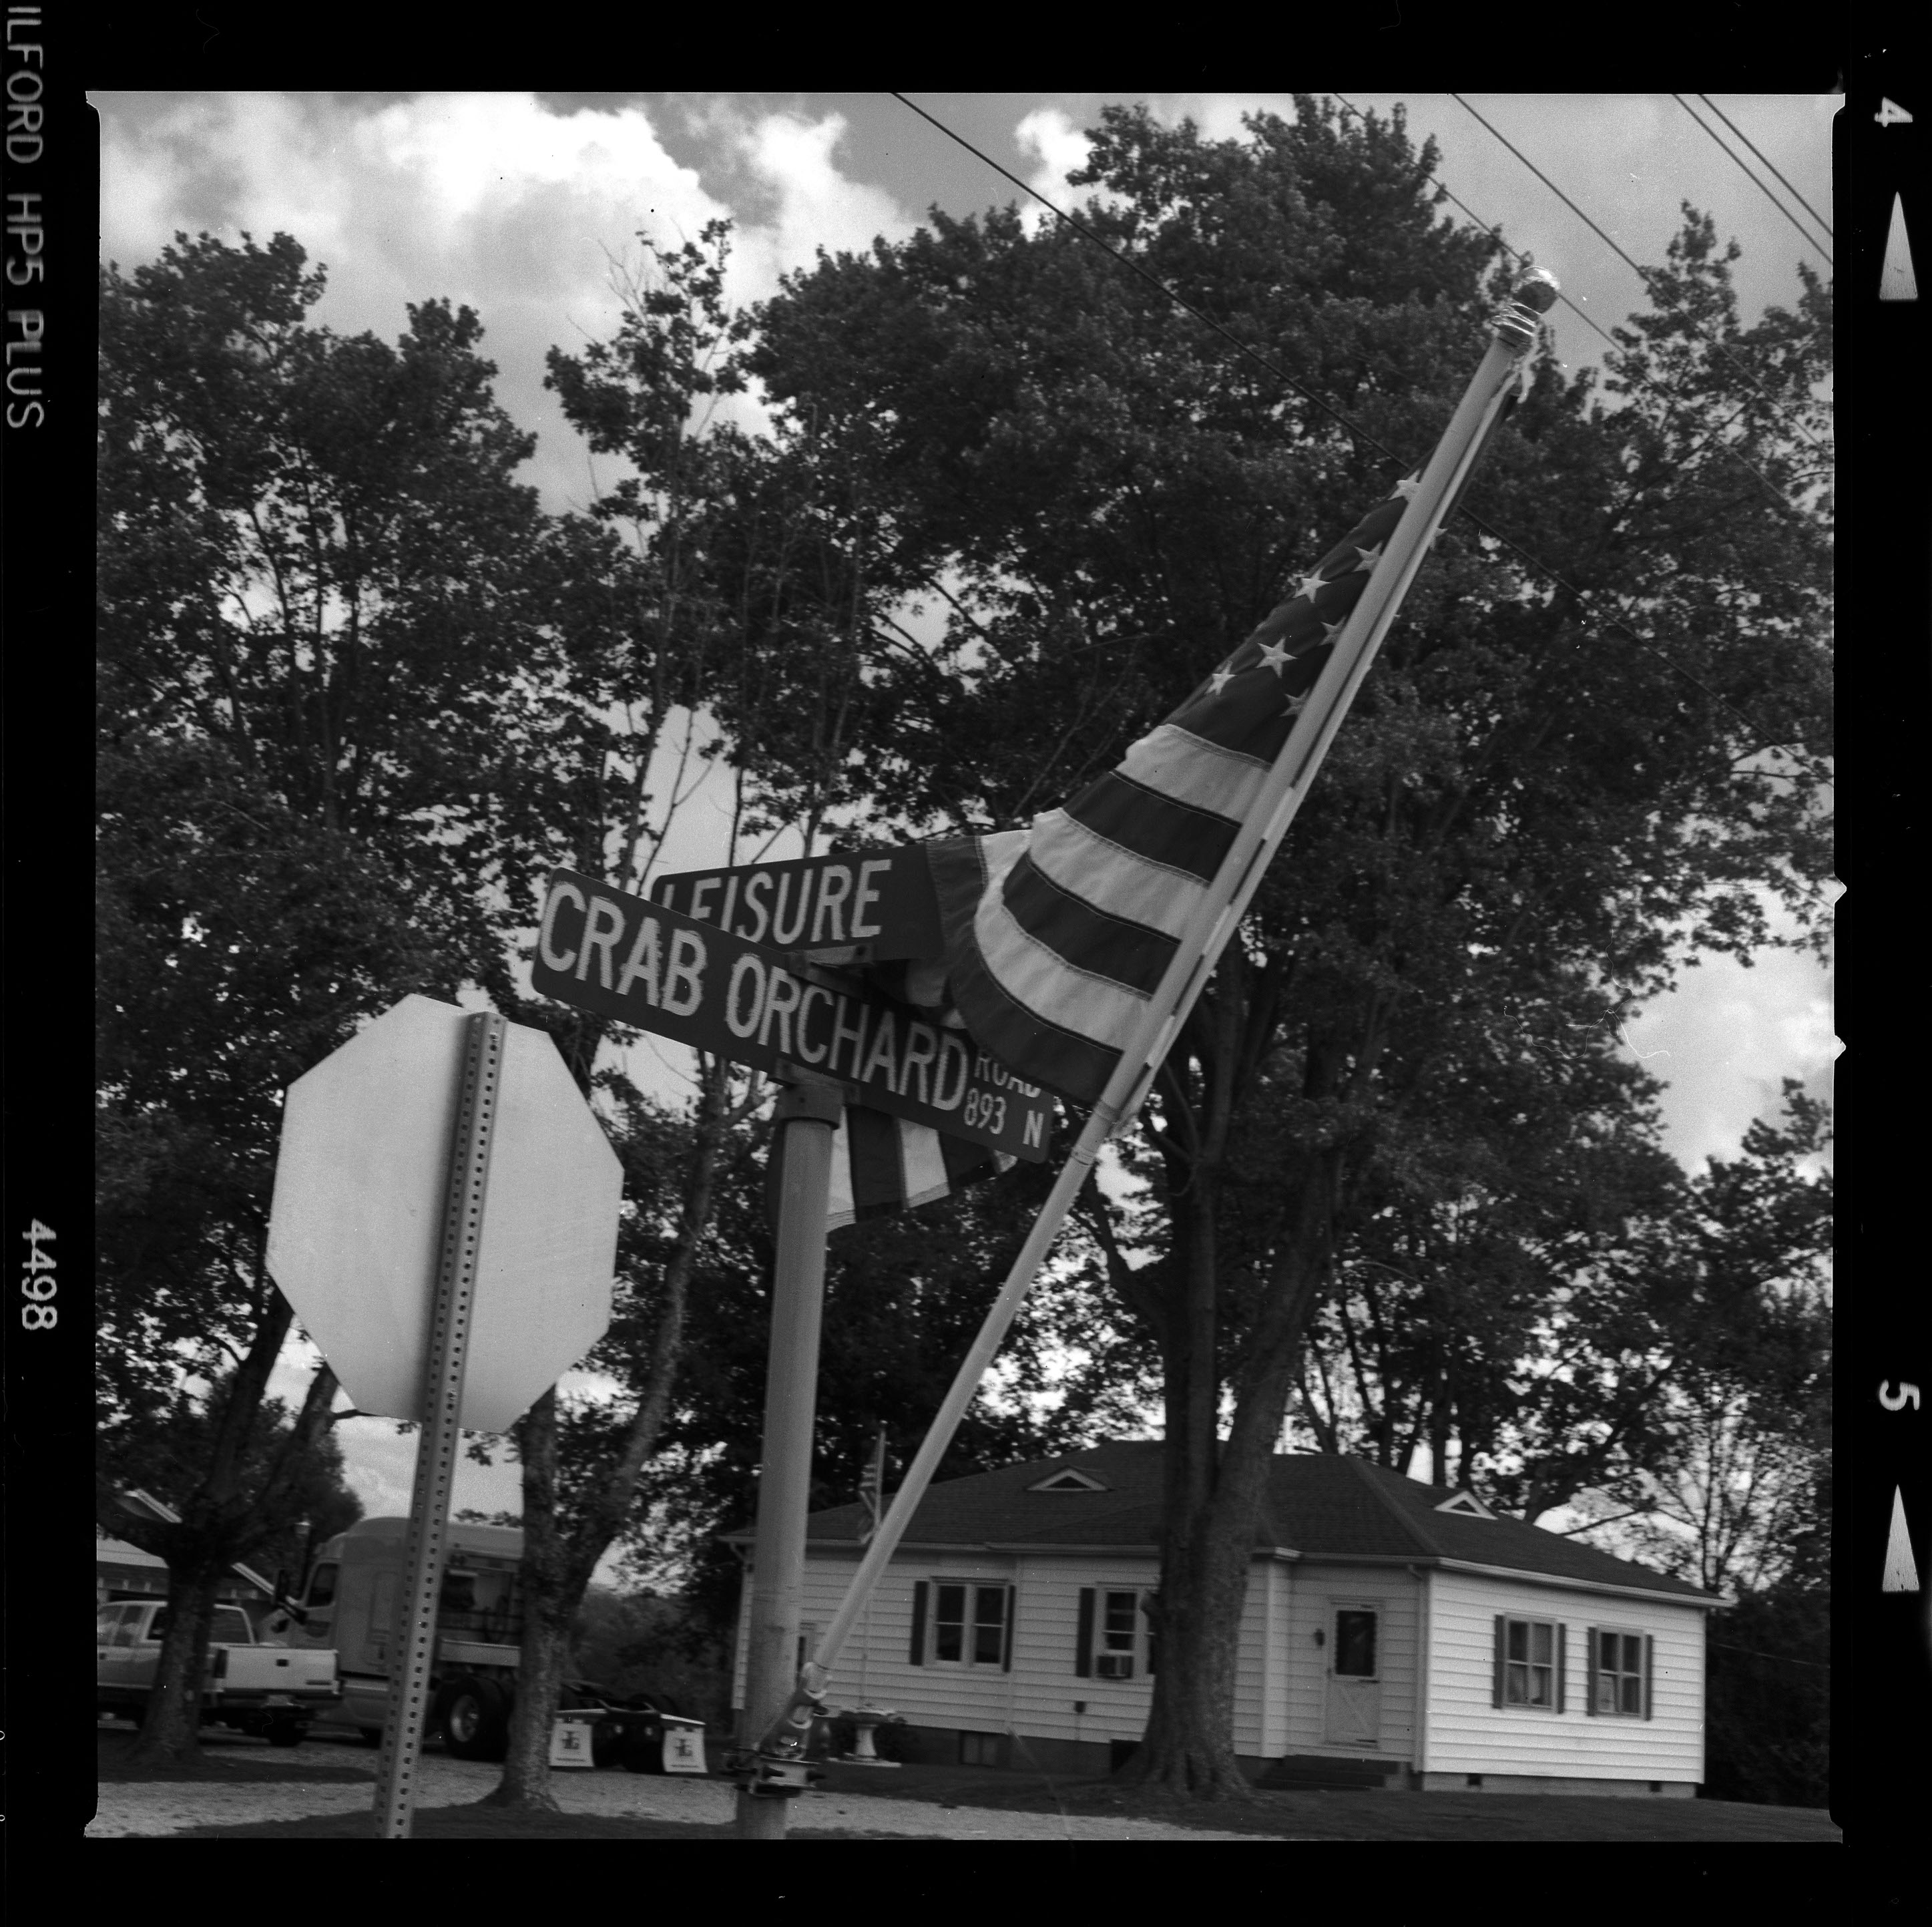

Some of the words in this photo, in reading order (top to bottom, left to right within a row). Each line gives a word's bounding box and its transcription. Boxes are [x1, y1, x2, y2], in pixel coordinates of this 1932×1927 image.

[6, 6, 43, 163] ILFORD
[1874, 96, 1913, 128] 4
[6, 194, 44, 285] HP5
[6, 310, 44, 428] PLUS
[539, 881, 708, 1016] CRAB
[725, 953, 967, 1111] ORCHARD
[964, 1087, 1007, 1134] 893
[1022, 1110, 1044, 1148] N
[21, 1218, 57, 1331] 4498
[1879, 1379, 1920, 1411] 5
